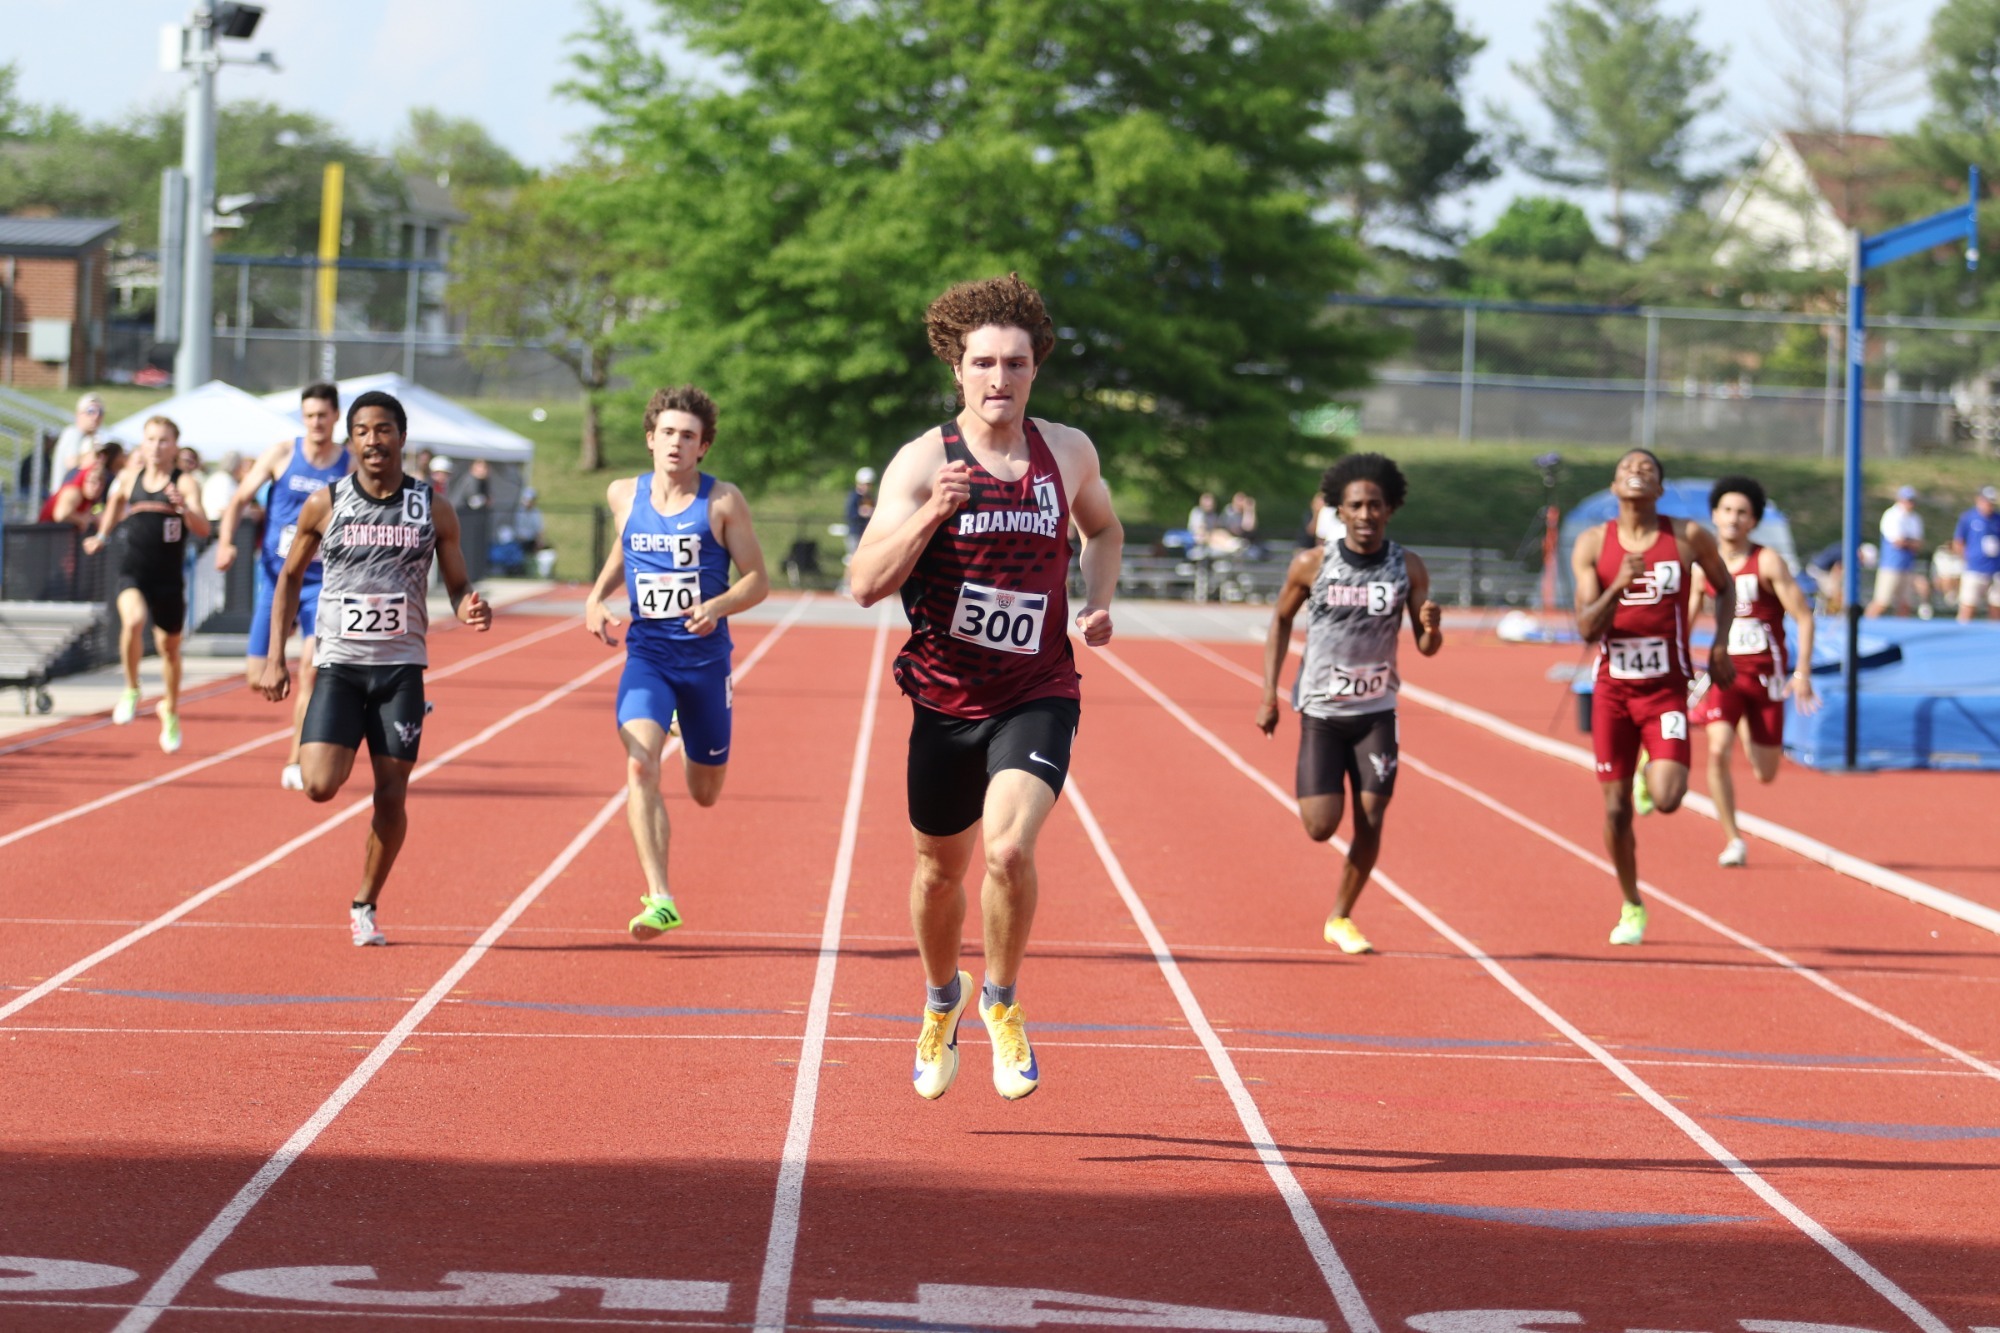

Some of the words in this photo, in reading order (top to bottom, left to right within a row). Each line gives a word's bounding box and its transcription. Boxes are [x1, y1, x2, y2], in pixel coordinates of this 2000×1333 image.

[407, 493, 423, 520] 6
[1039, 486, 1053, 516] 4
[344, 524, 420, 548] LYNCHBURG
[959, 511, 1057, 539] ROANOKE
[630, 533, 701, 552] GENERS
[679, 538, 693, 566] 5
[1662, 566, 1674, 590] 2
[643, 588, 693, 612] 470
[1374, 585, 1387, 612] 3
[347, 609, 400, 632] 223
[958, 604, 1034, 647] 300
[1616, 651, 1661, 672] 144
[1335, 676, 1382, 696] 200
[1669, 716, 1680, 735] 2
